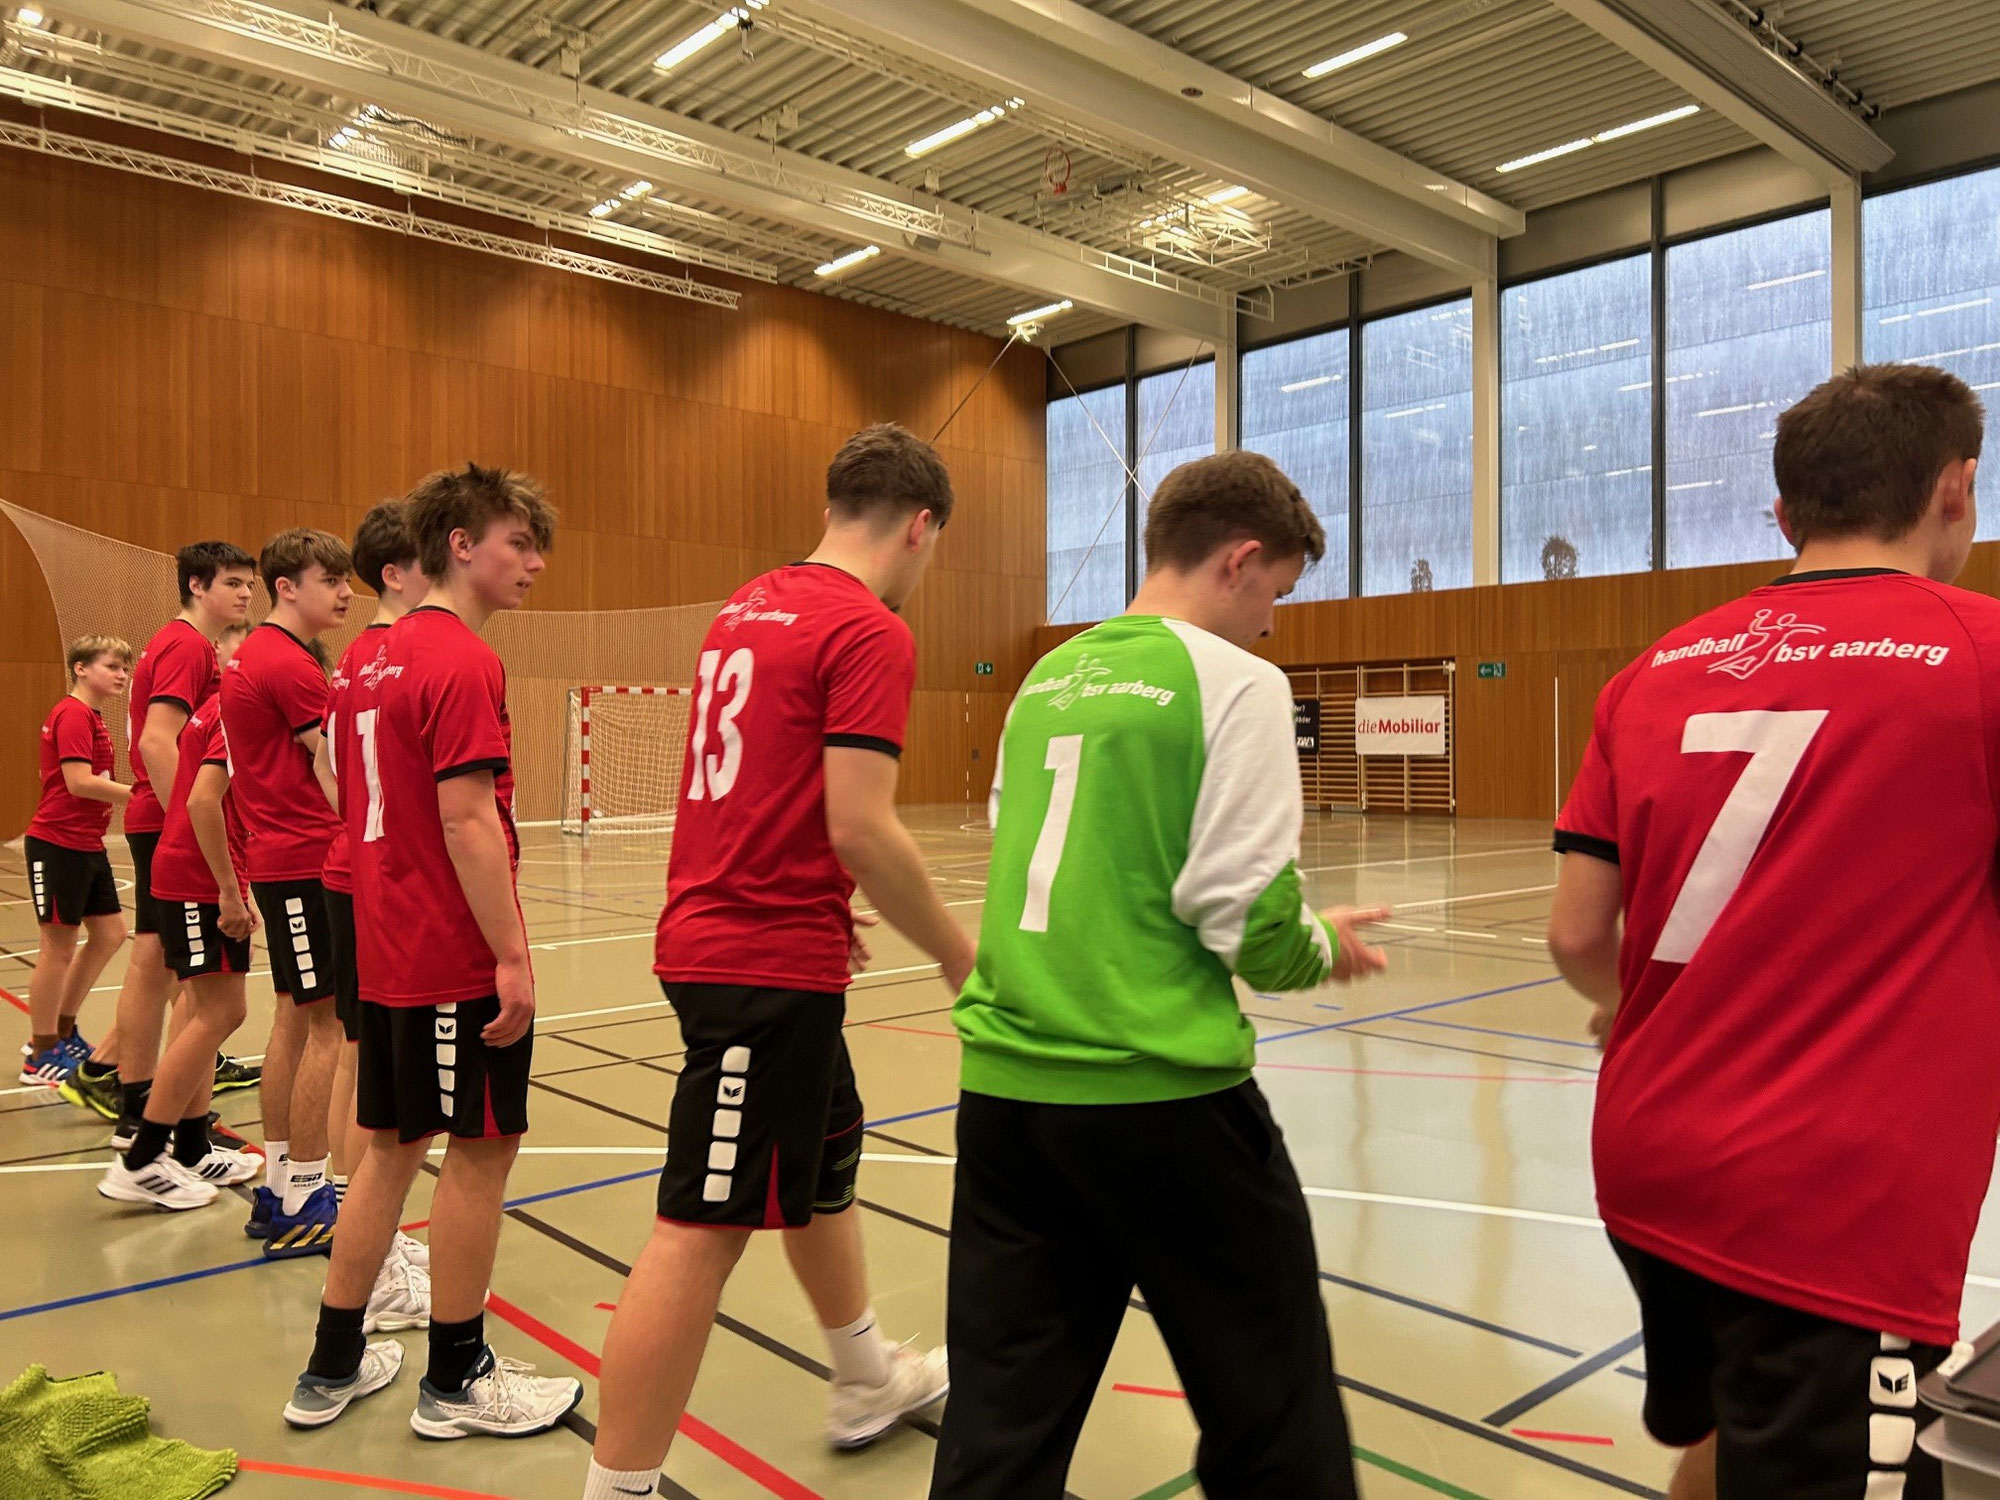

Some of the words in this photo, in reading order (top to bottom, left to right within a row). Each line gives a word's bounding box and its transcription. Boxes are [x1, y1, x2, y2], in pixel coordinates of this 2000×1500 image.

[687, 648, 755, 802] 13
[1107, 679, 1176, 706] aarberg
[1651, 633, 1749, 668] handball
[1774, 643, 1825, 663] bsv
[1829, 637, 1950, 666] aarberg
[1018, 734, 1084, 932] 1
[1651, 709, 1830, 964] 7
